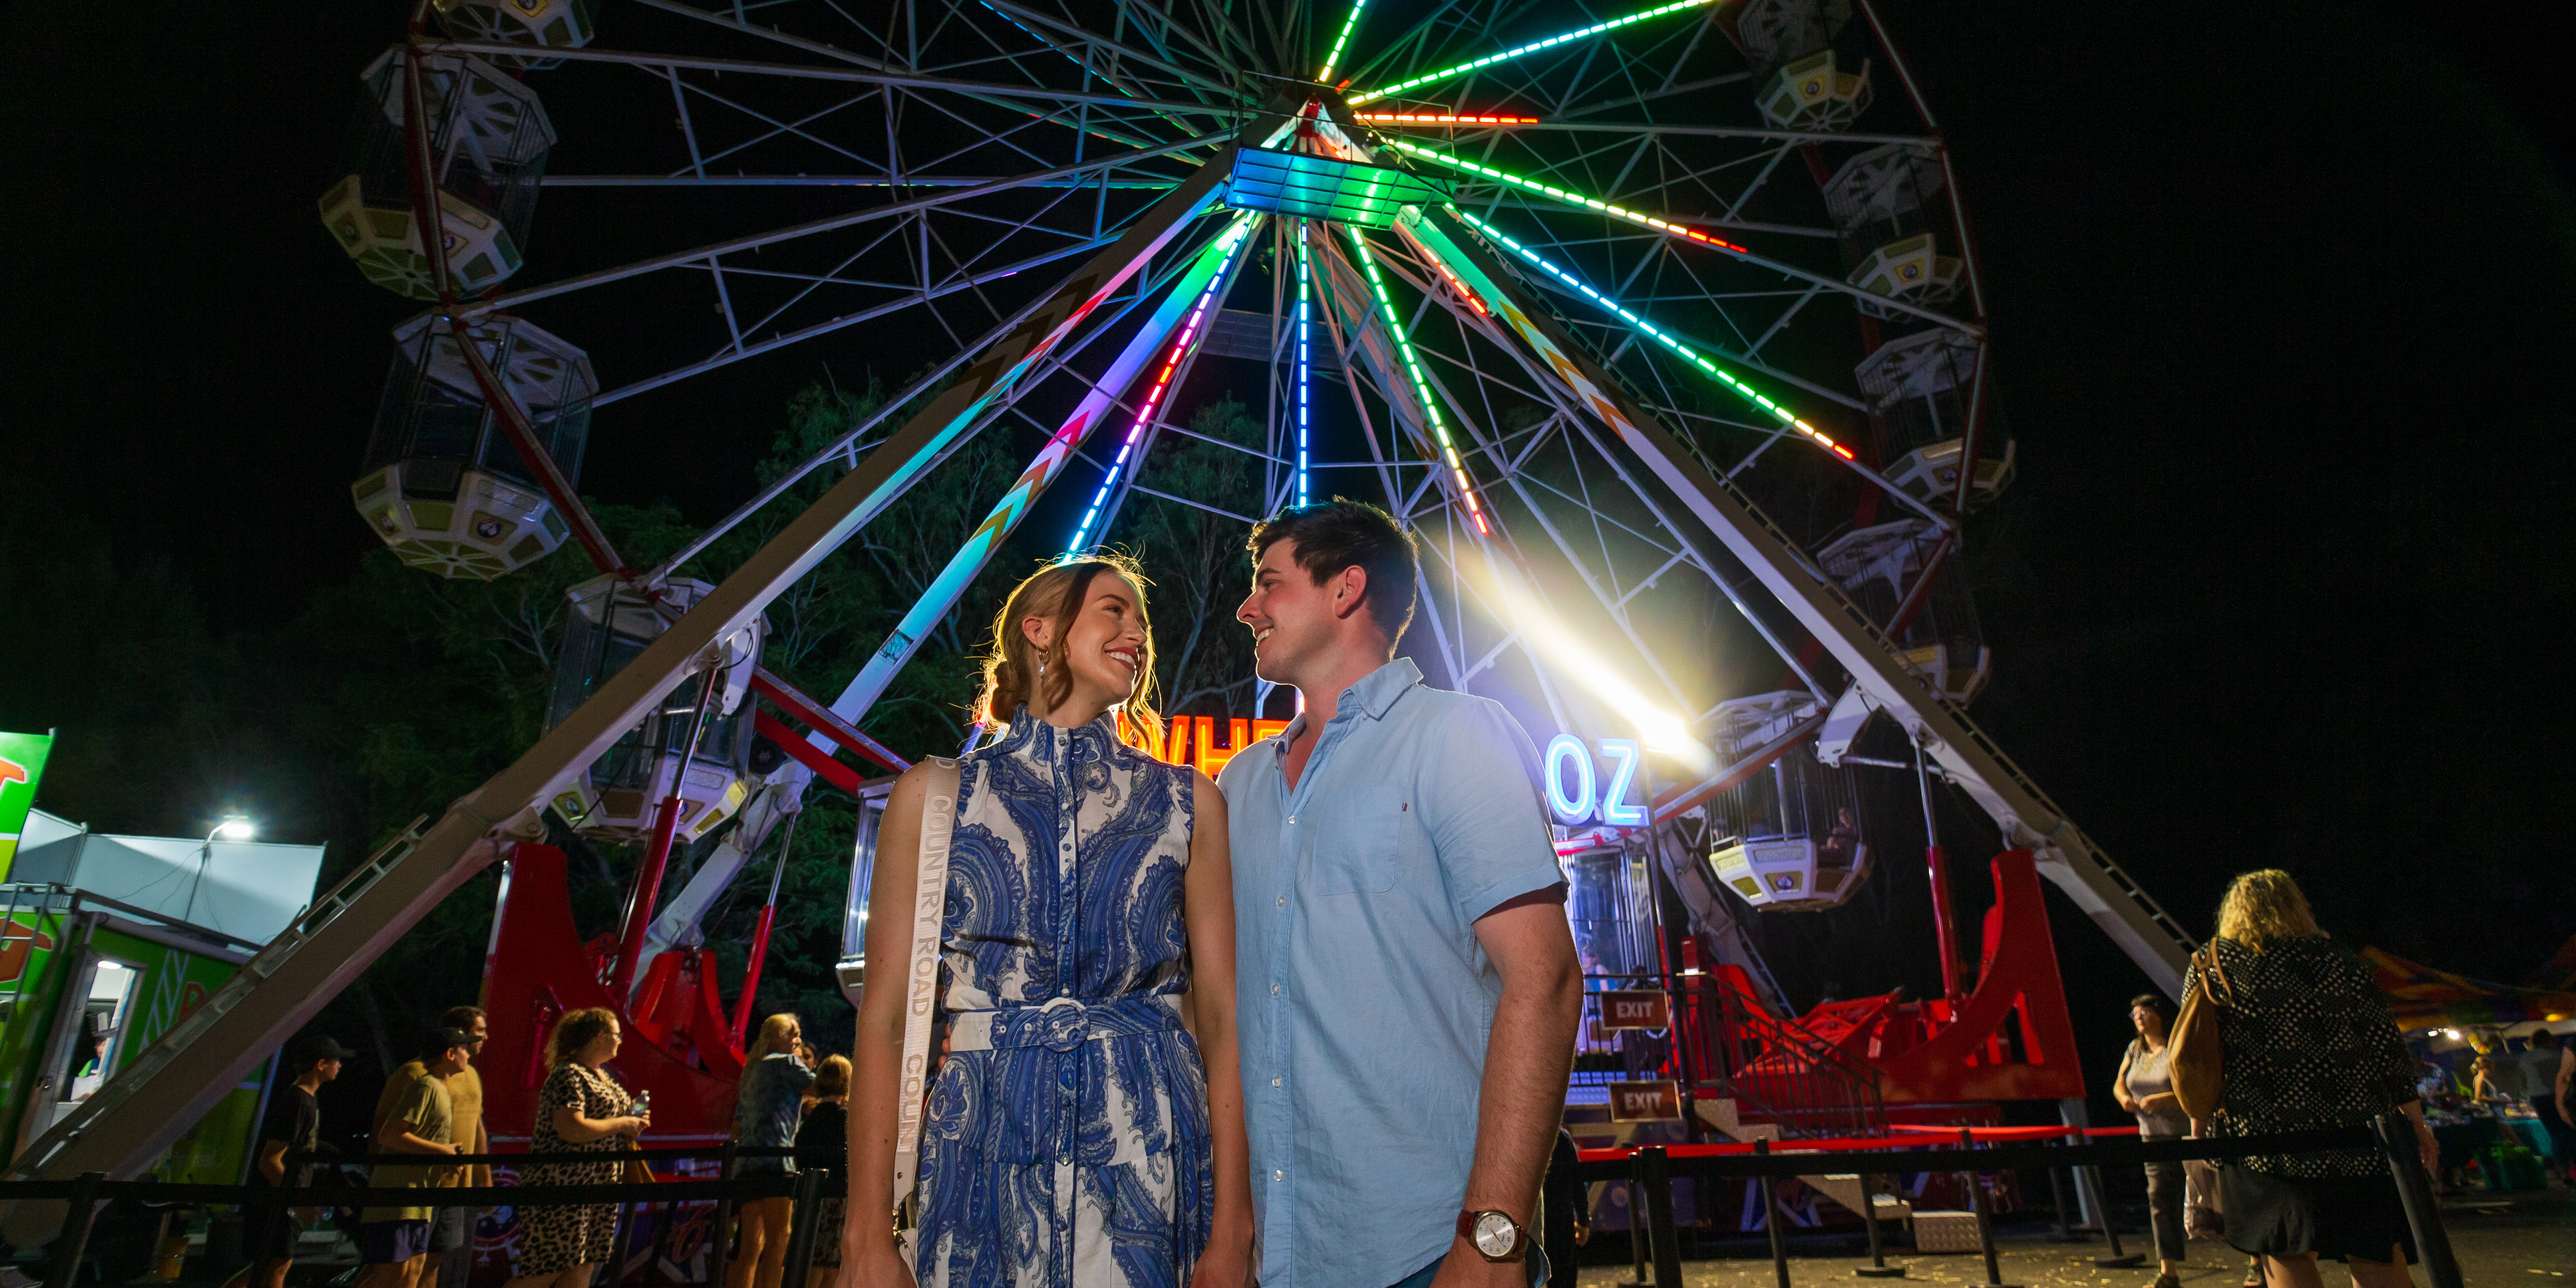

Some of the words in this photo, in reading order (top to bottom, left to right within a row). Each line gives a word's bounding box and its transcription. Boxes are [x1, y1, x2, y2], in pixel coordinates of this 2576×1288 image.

[1545, 733, 1650, 826] OZ
[920, 796, 952, 925] COUNTRY
[912, 936, 937, 1016] ROAD
[1616, 1002, 1653, 1018] EXIT
[899, 1053, 923, 1147] COUN
[1624, 1093, 1662, 1110] EXIT
